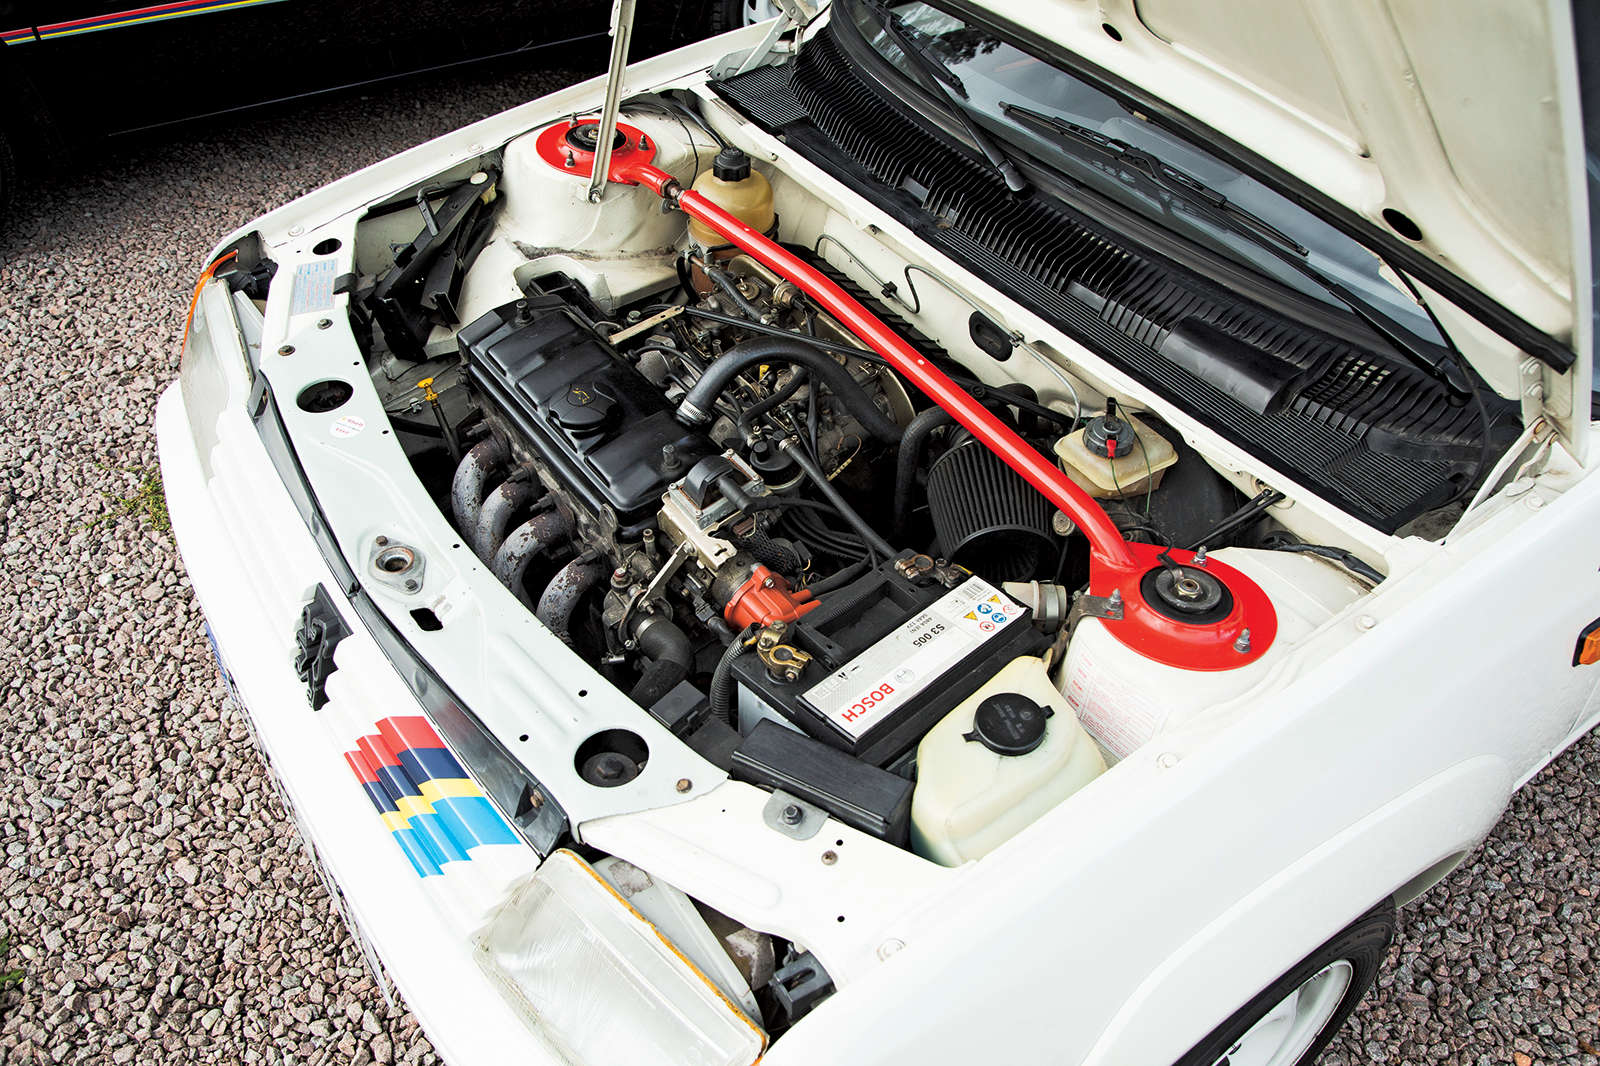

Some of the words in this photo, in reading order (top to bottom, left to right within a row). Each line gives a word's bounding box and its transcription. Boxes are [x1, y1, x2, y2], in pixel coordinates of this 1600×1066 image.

[930, 623, 945, 635] S3
[912, 633, 932, 648] 005
[842, 683, 895, 723] BOSCH
